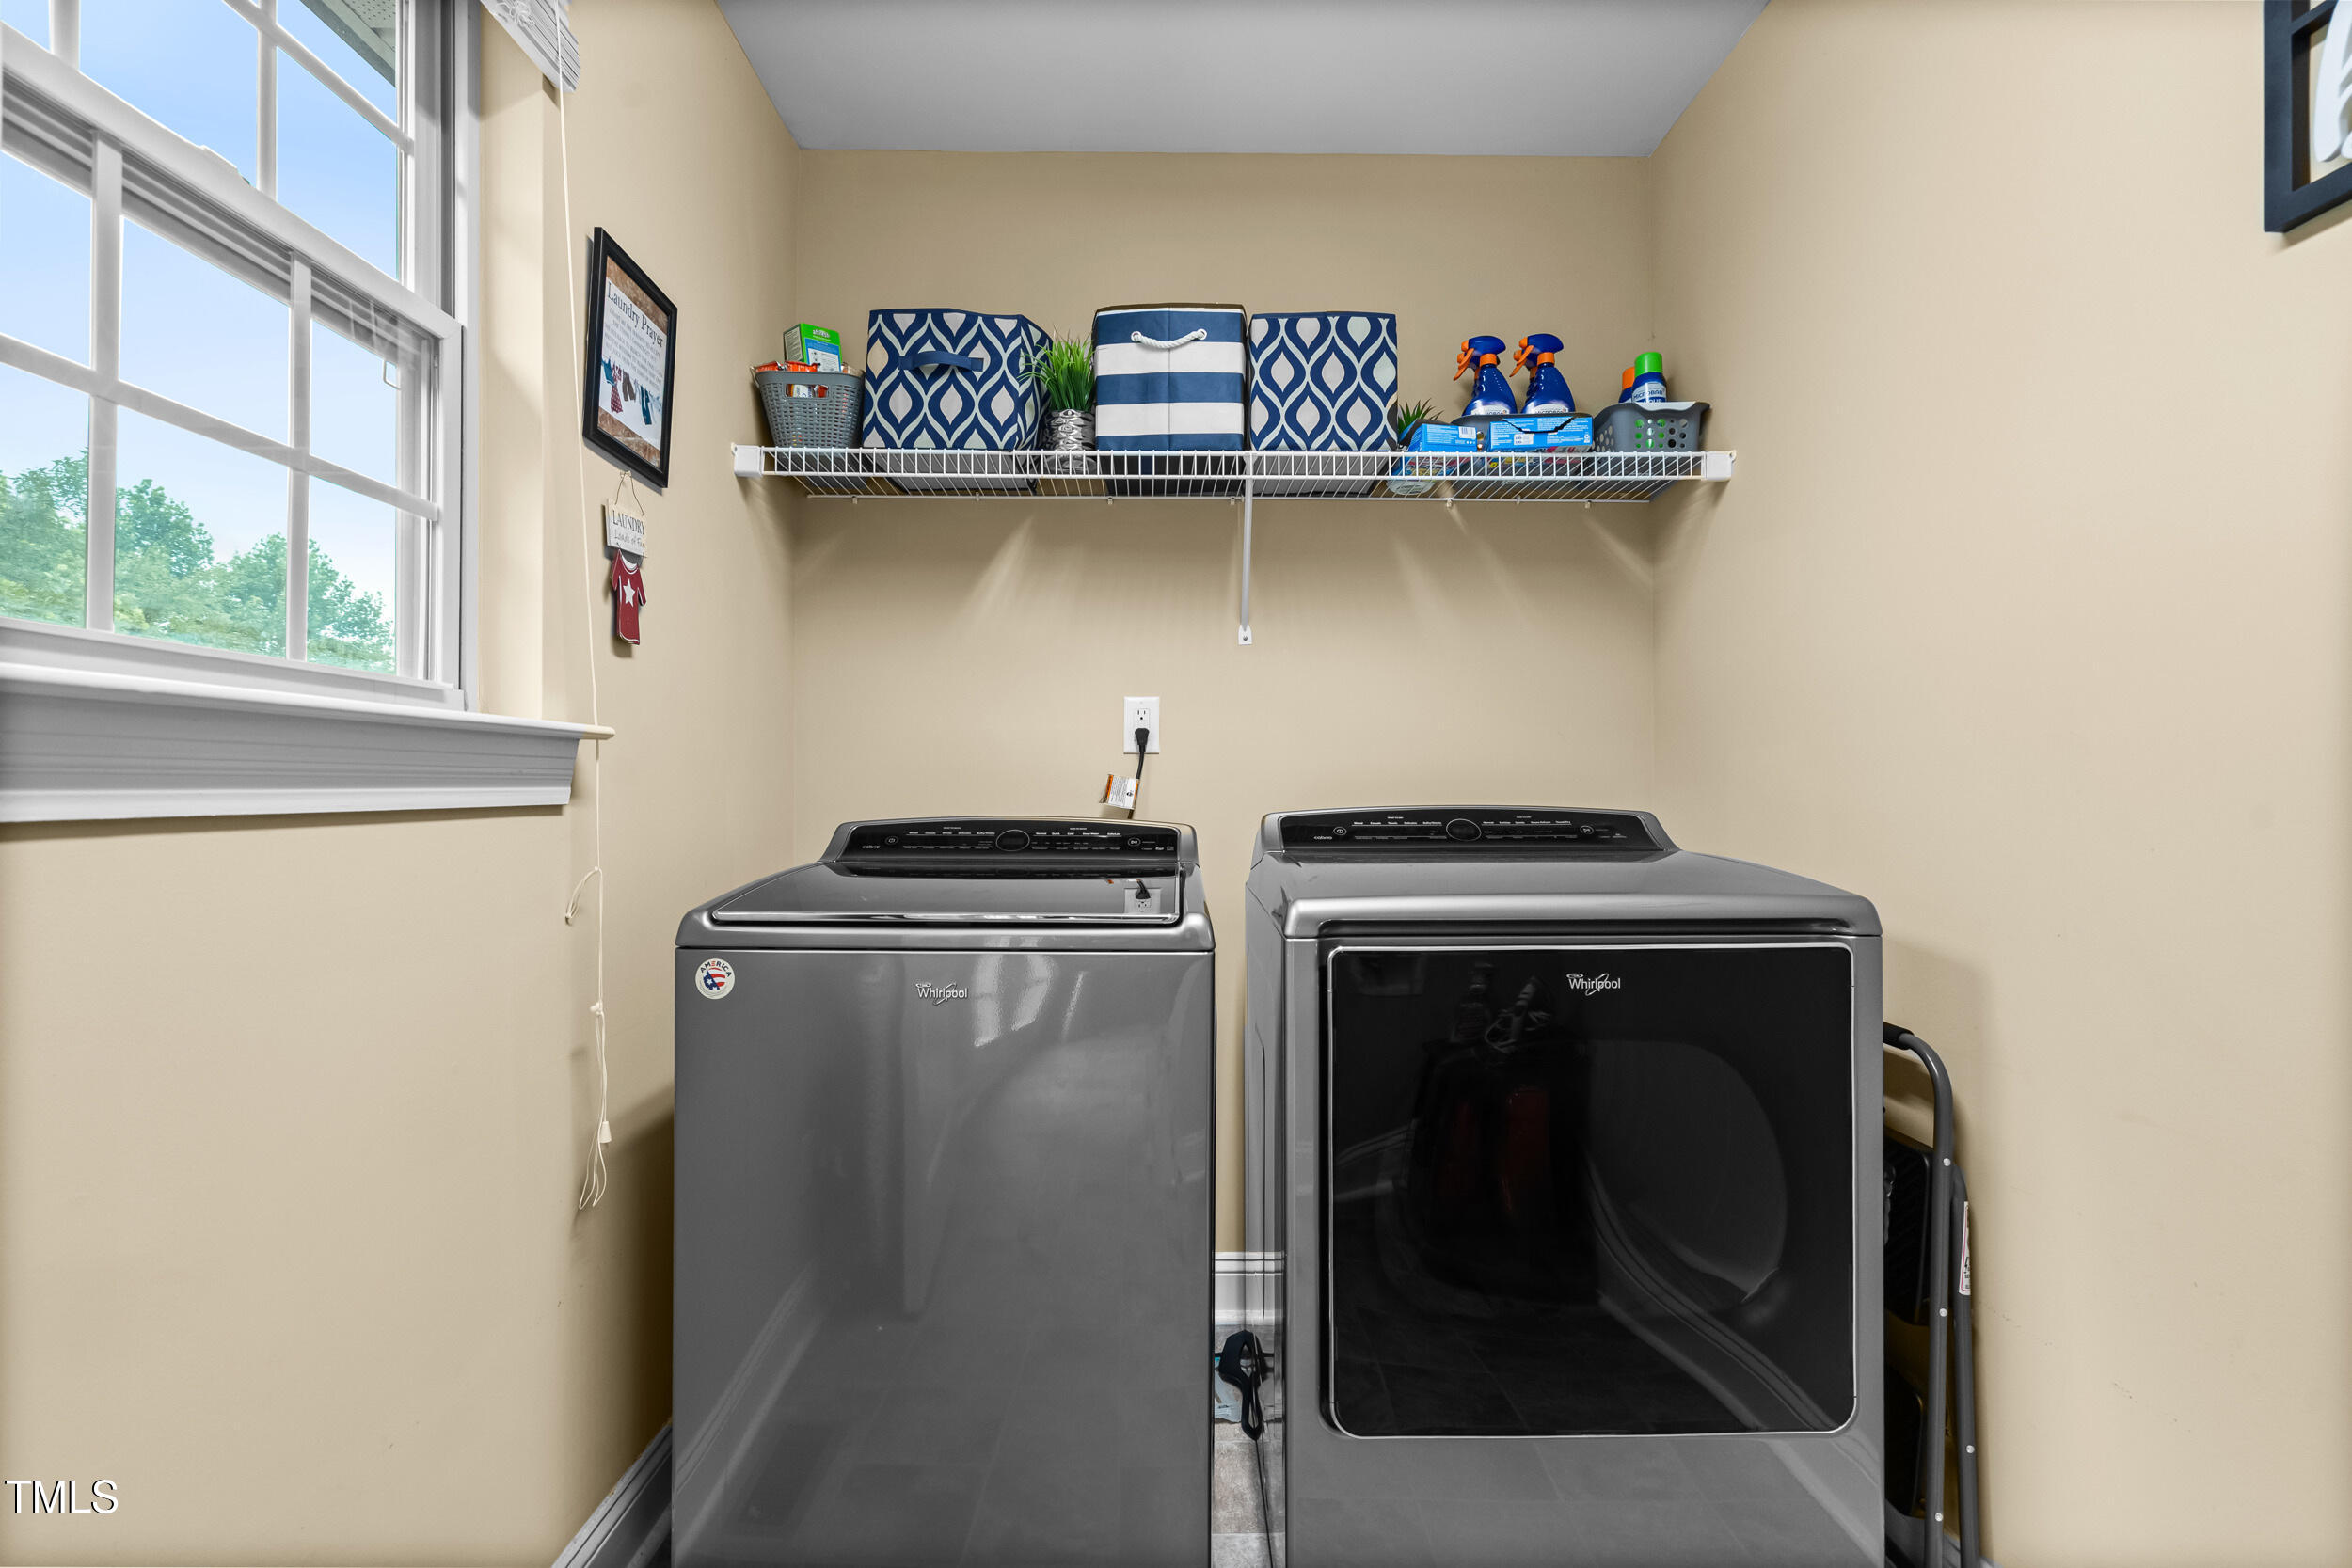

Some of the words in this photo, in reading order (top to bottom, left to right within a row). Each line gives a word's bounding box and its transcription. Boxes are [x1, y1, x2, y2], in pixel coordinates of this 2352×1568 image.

[607, 282, 640, 328] Laundry
[641, 314, 664, 348] Prayer
[612, 509, 645, 535] LAUNDRY
[700, 960, 732, 977] AMERICA
[916, 984, 968, 1004] Whirlpool
[1567, 975, 1621, 995] Whirlpool
